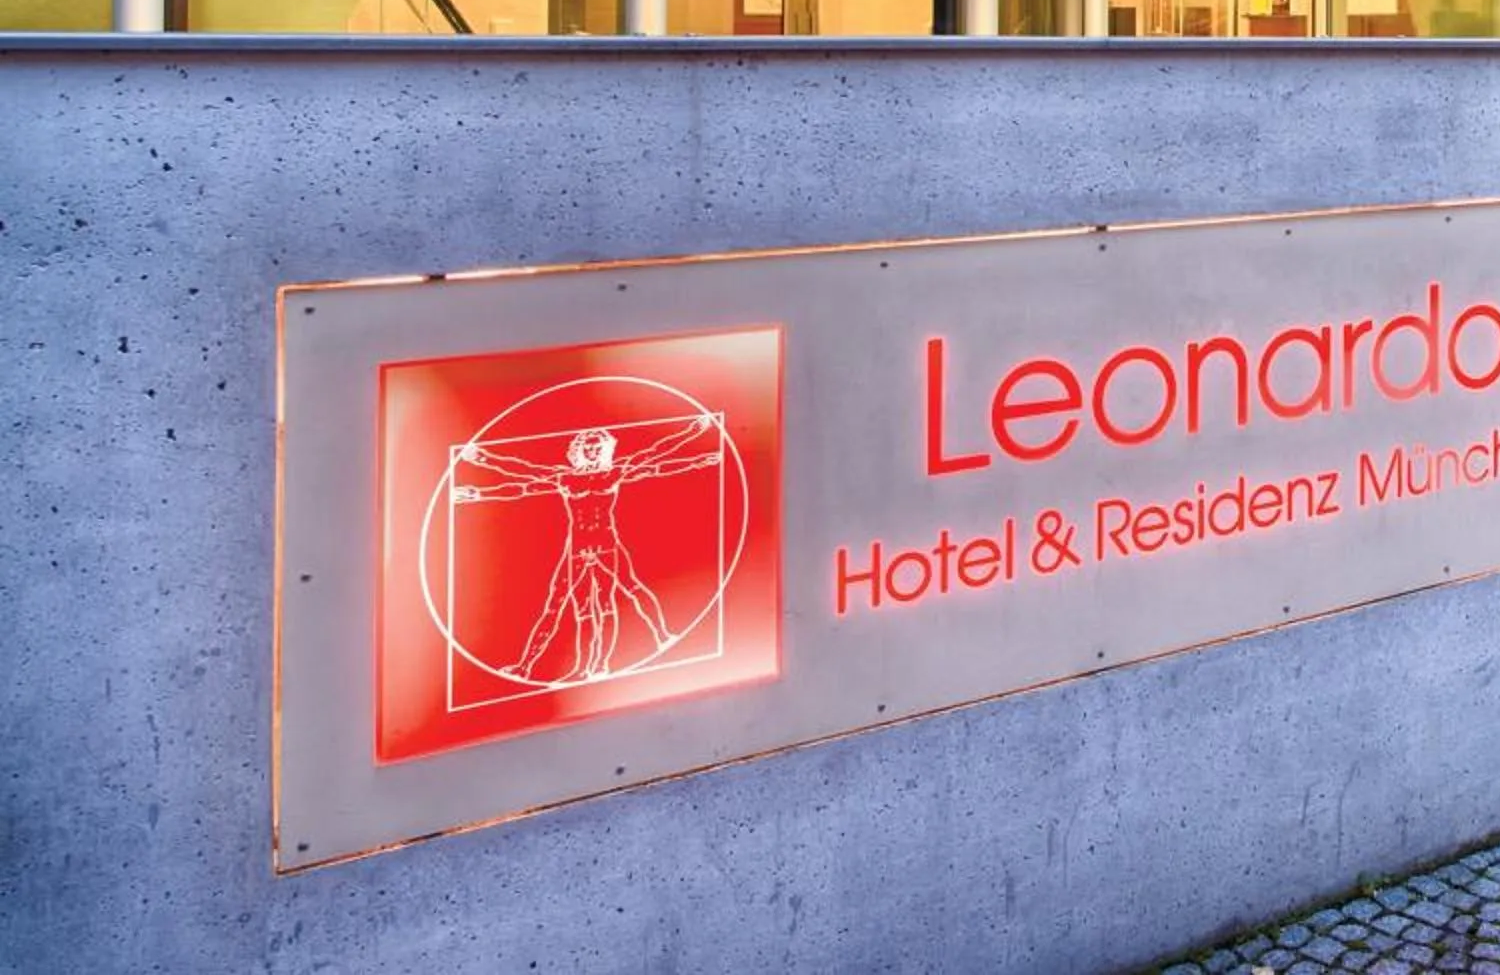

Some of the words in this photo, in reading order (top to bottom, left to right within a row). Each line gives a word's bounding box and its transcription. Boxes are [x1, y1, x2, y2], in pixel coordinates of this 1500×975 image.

[834, 519, 1015, 616] Hotel
[1028, 509, 1084, 574] &
[1094, 471, 1341, 561] Residenz
